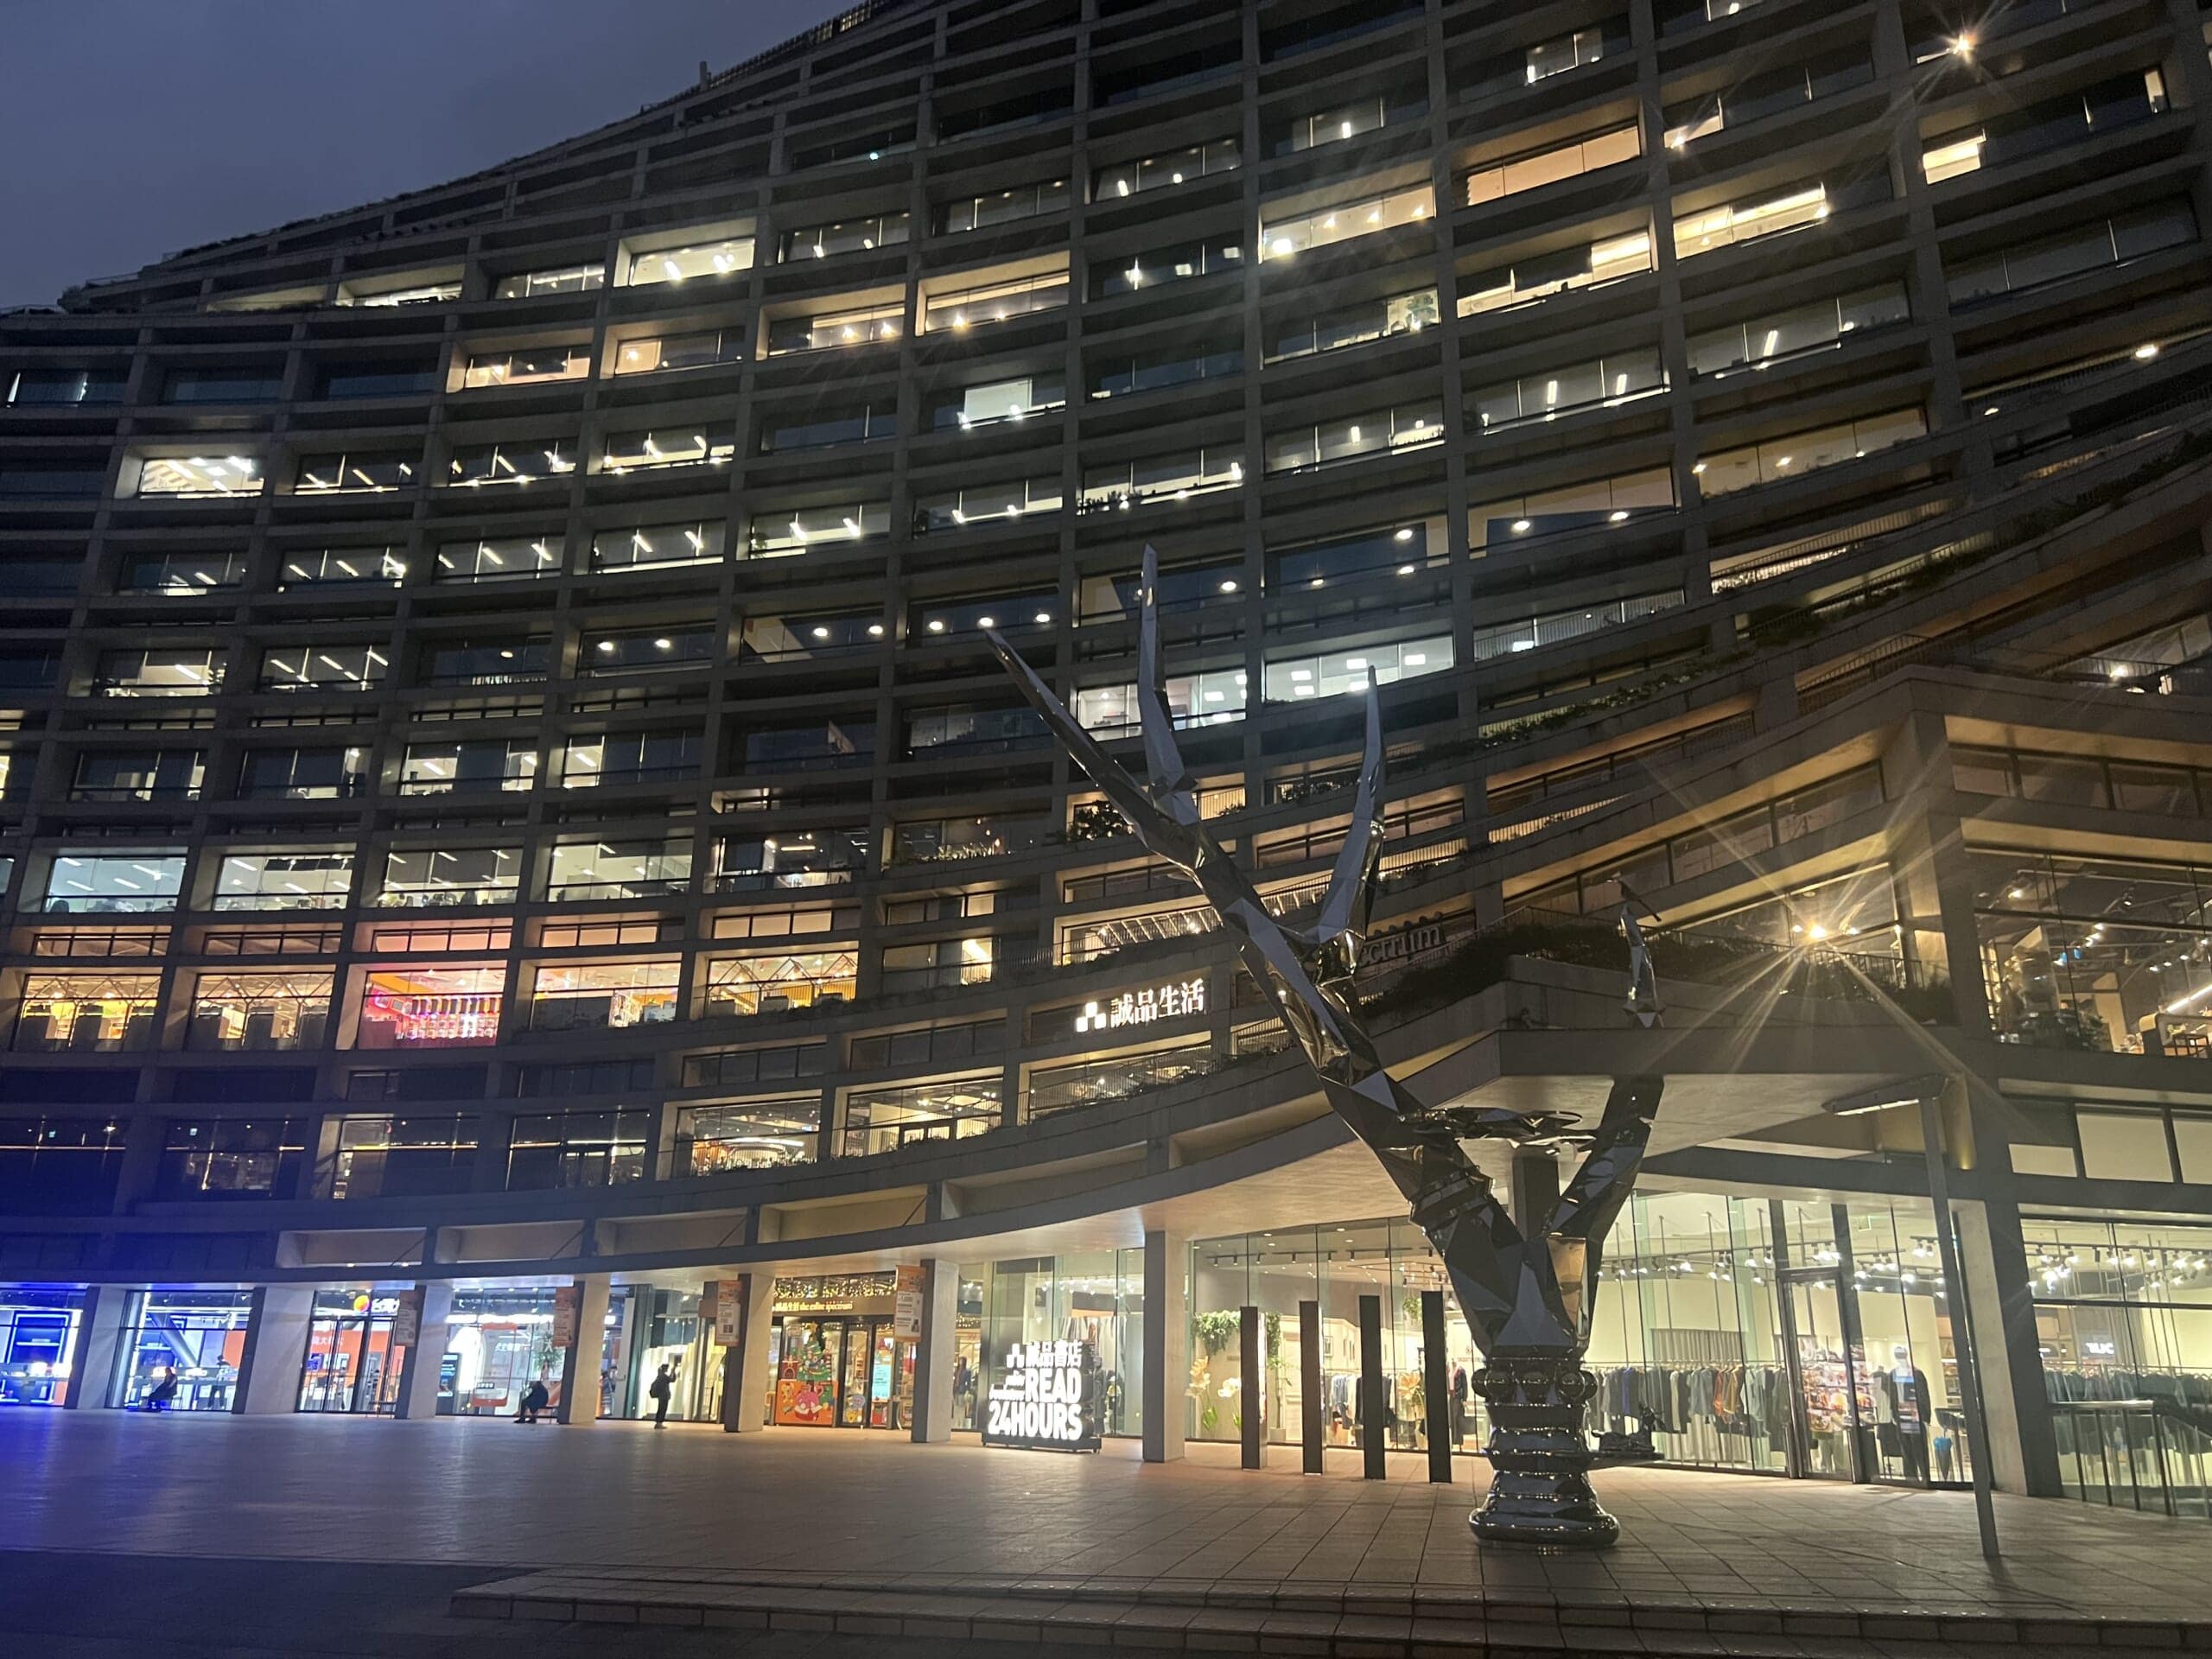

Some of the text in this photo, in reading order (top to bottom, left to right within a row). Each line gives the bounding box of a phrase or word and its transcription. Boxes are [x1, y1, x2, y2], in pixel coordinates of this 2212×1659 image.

[1110, 978, 1205, 1028] 誠品生活
[1025, 1339, 1083, 1369] 誠品書店
[1025, 1368, 1082, 1403] READ
[988, 1400, 1083, 1440] 24HOURS
